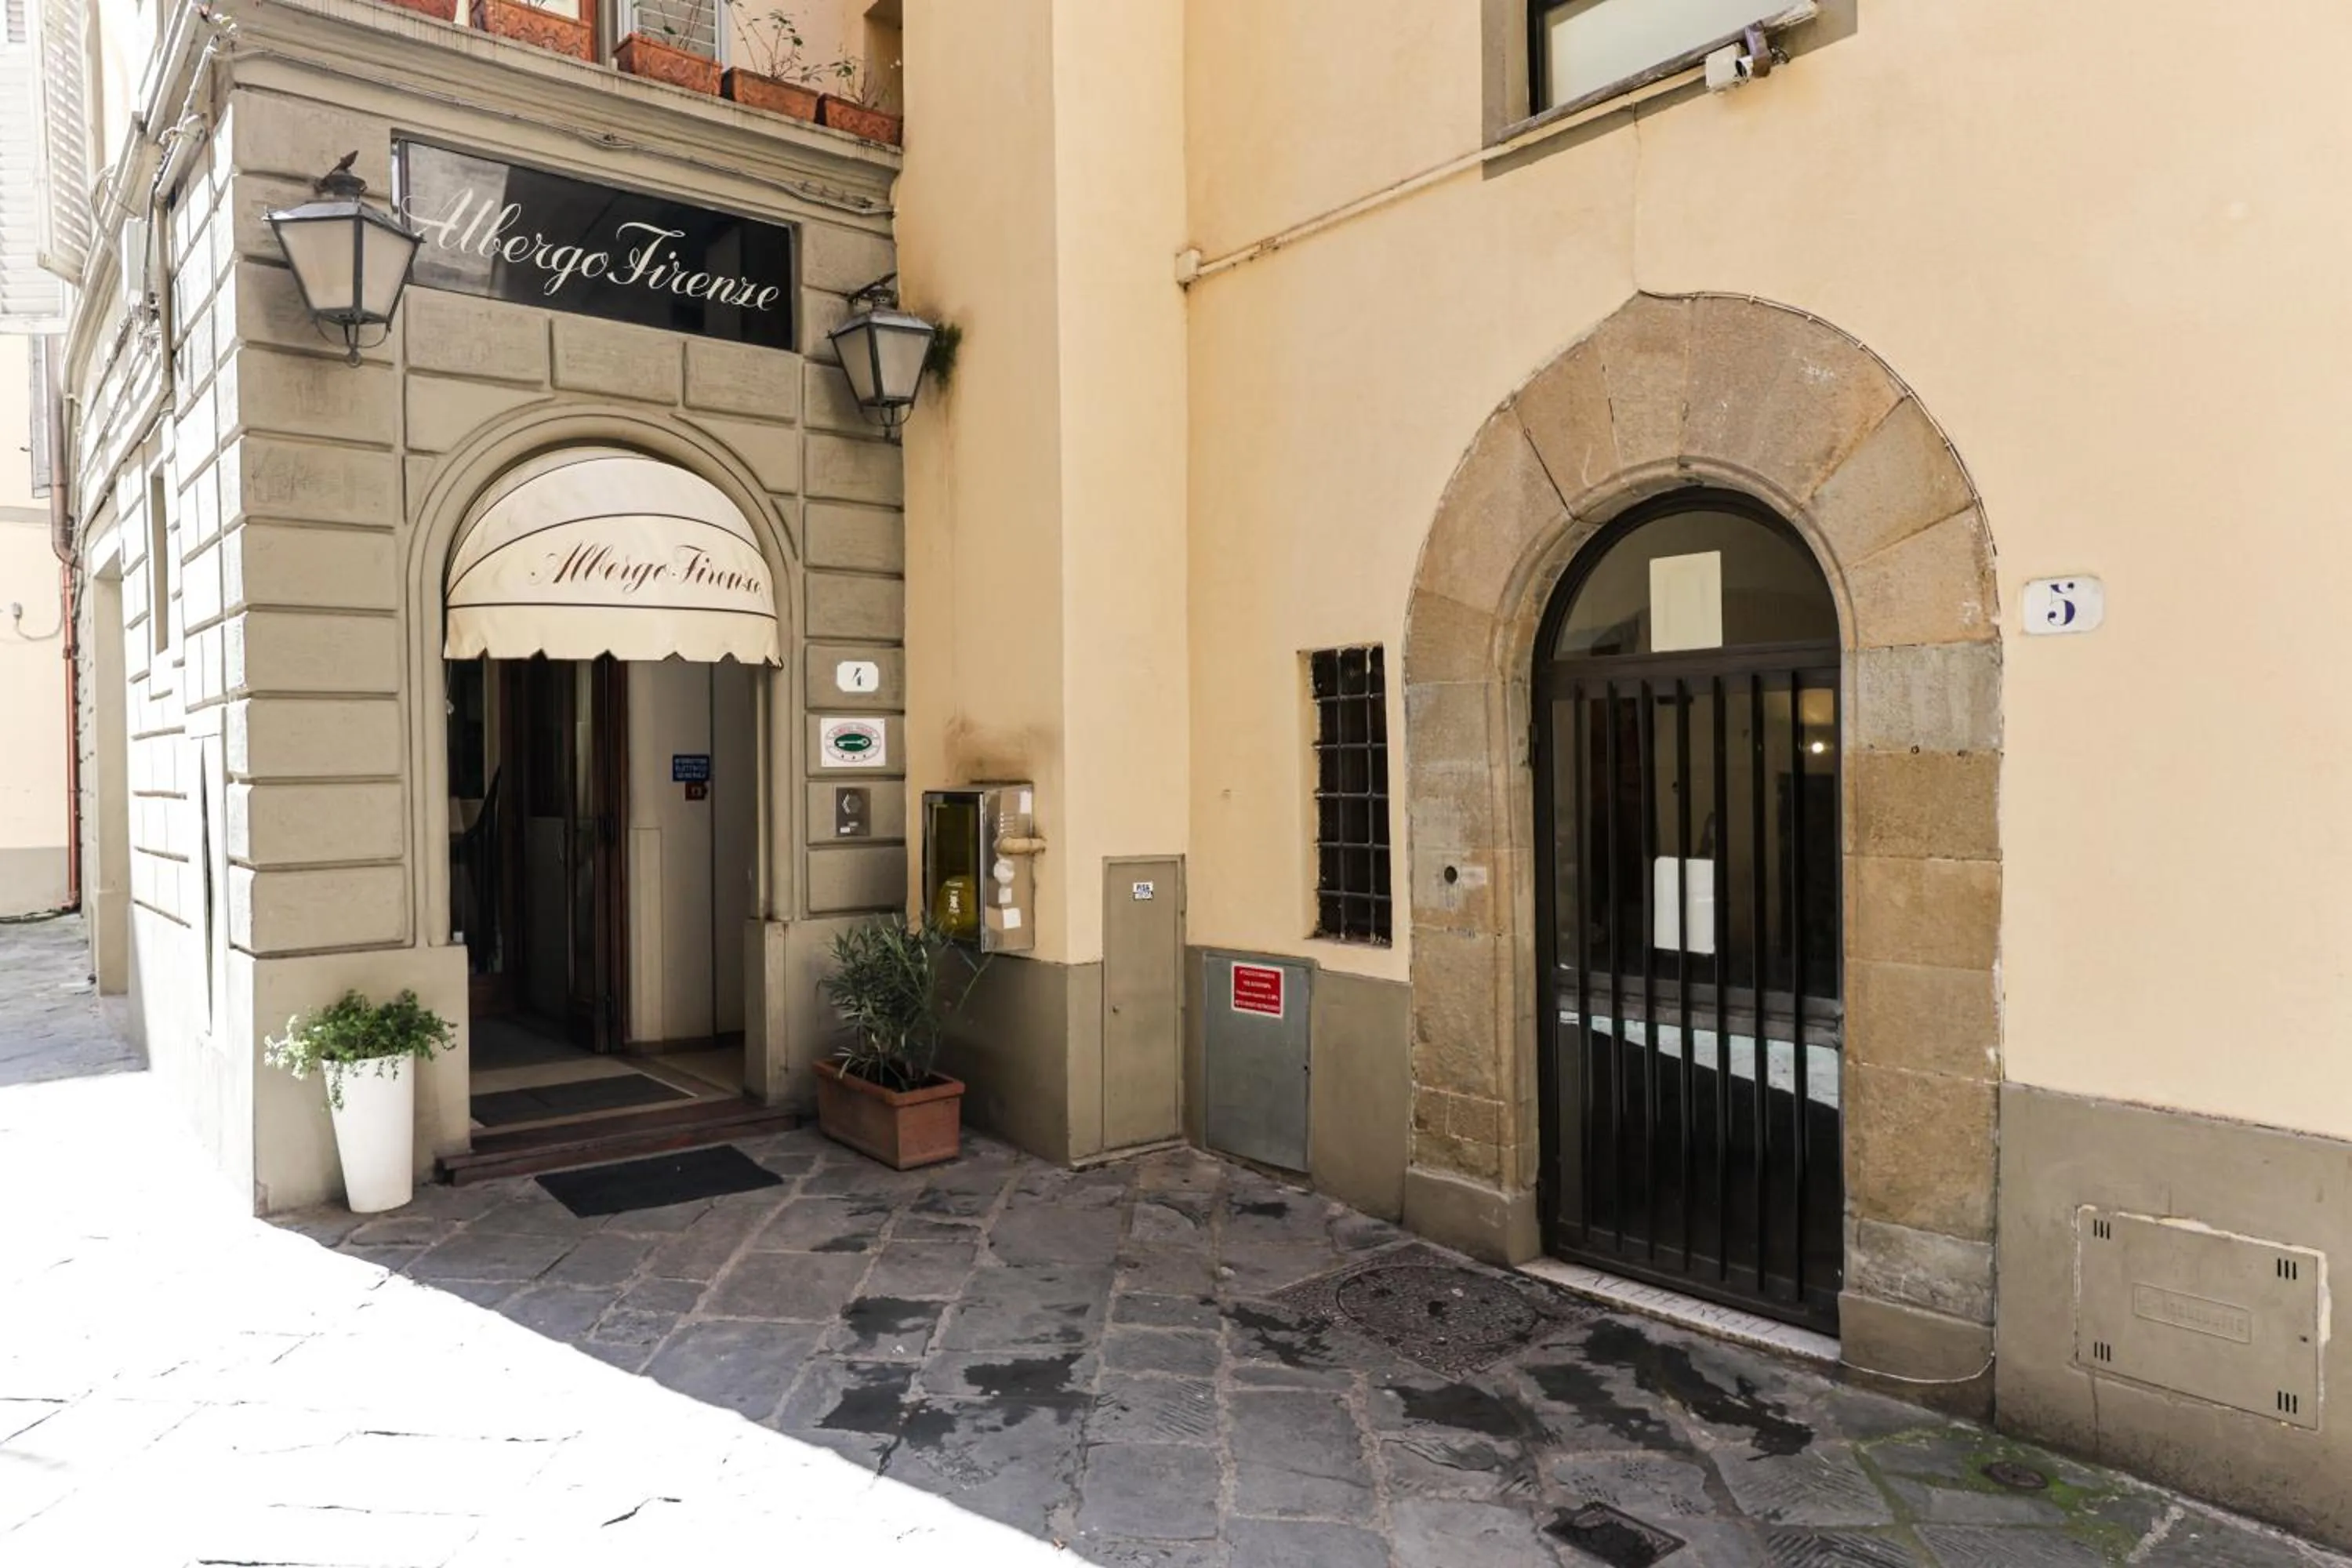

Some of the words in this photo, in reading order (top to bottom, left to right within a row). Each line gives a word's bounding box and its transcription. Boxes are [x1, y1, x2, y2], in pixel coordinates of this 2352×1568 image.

[401, 187, 610, 296] Albergo
[606, 221, 780, 311] Firenze
[530, 540, 670, 593] Albergo
[672, 544, 764, 594] Firenze
[2047, 582, 2075, 626] 5
